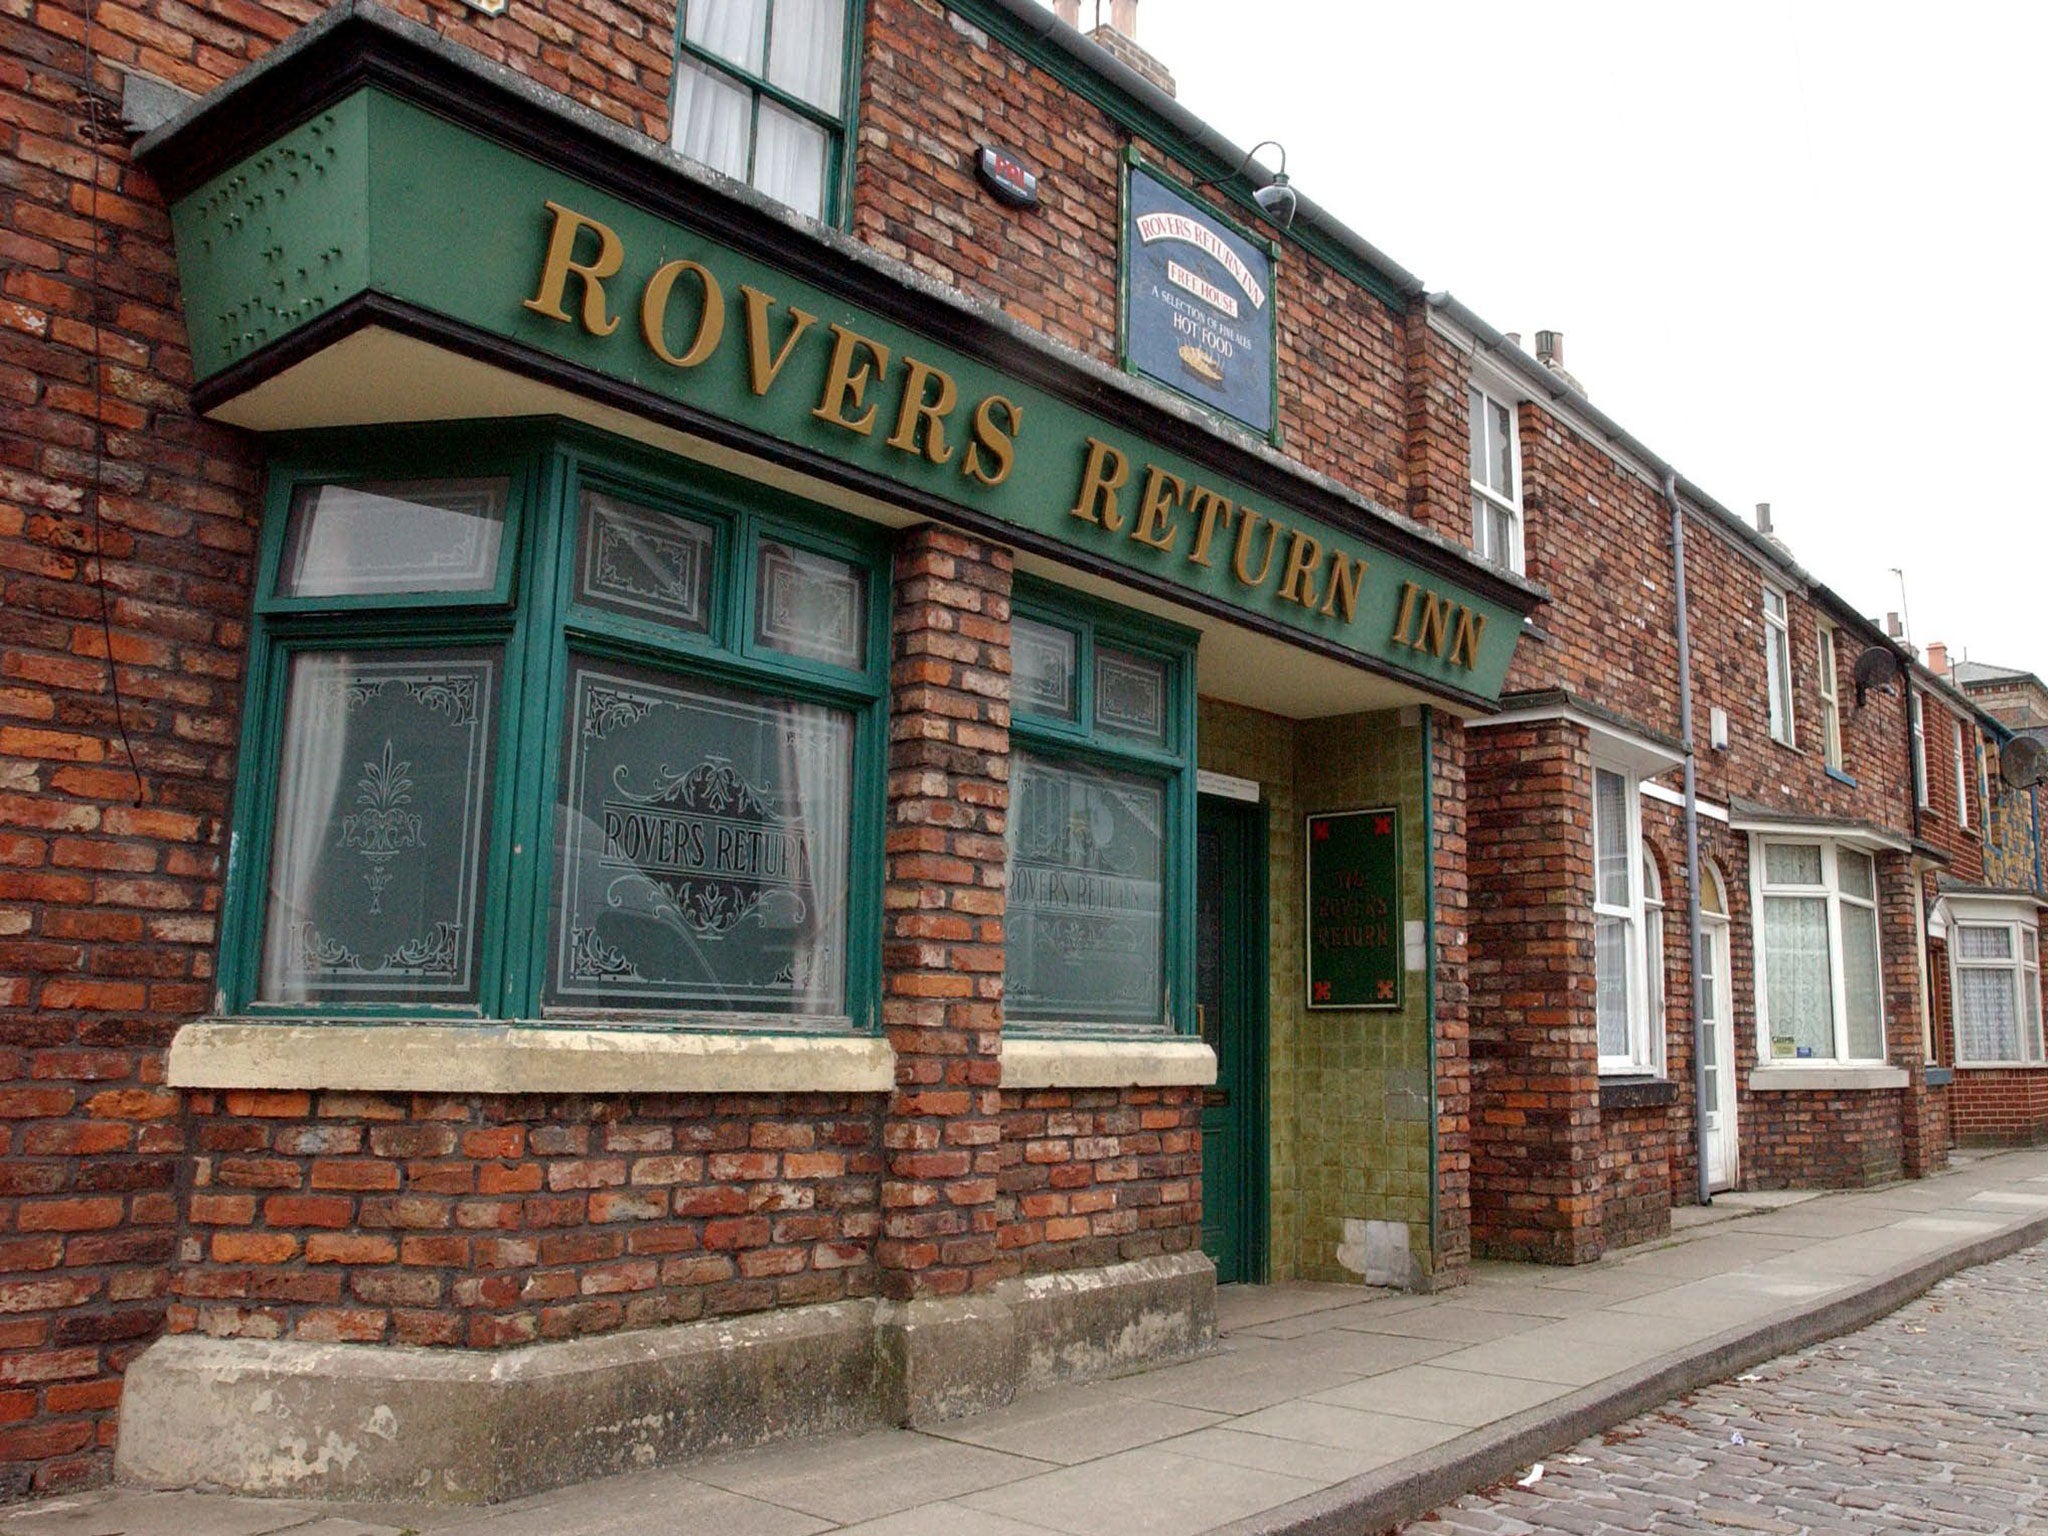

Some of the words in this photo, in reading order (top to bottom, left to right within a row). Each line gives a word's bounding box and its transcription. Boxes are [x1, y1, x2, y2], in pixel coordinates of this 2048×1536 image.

[1141, 216, 1193, 240] ROVERS
[1194, 223, 1241, 275] RETURN
[1242, 272, 1262, 304] INN
[1170, 264, 1197, 292] FREE
[1201, 282, 1237, 315] HOUSE
[1151, 285, 1159, 298] A
[1161, 290, 1206, 324] SELECTION
[1207, 316, 1218, 331] OF
[1219, 323, 1235, 343] FINE
[1235, 334, 1253, 351] ALES
[1173, 311, 1197, 339] HOT
[1202, 327, 1234, 358] FOOD
[522, 200, 1022, 486] ROVERS
[1071, 436, 1369, 624] RETURN
[1392, 580, 1488, 671] INN
[603, 809, 705, 869] ROVERS
[715, 825, 812, 881] RETURN
[1317, 922, 1387, 945] RETURN
